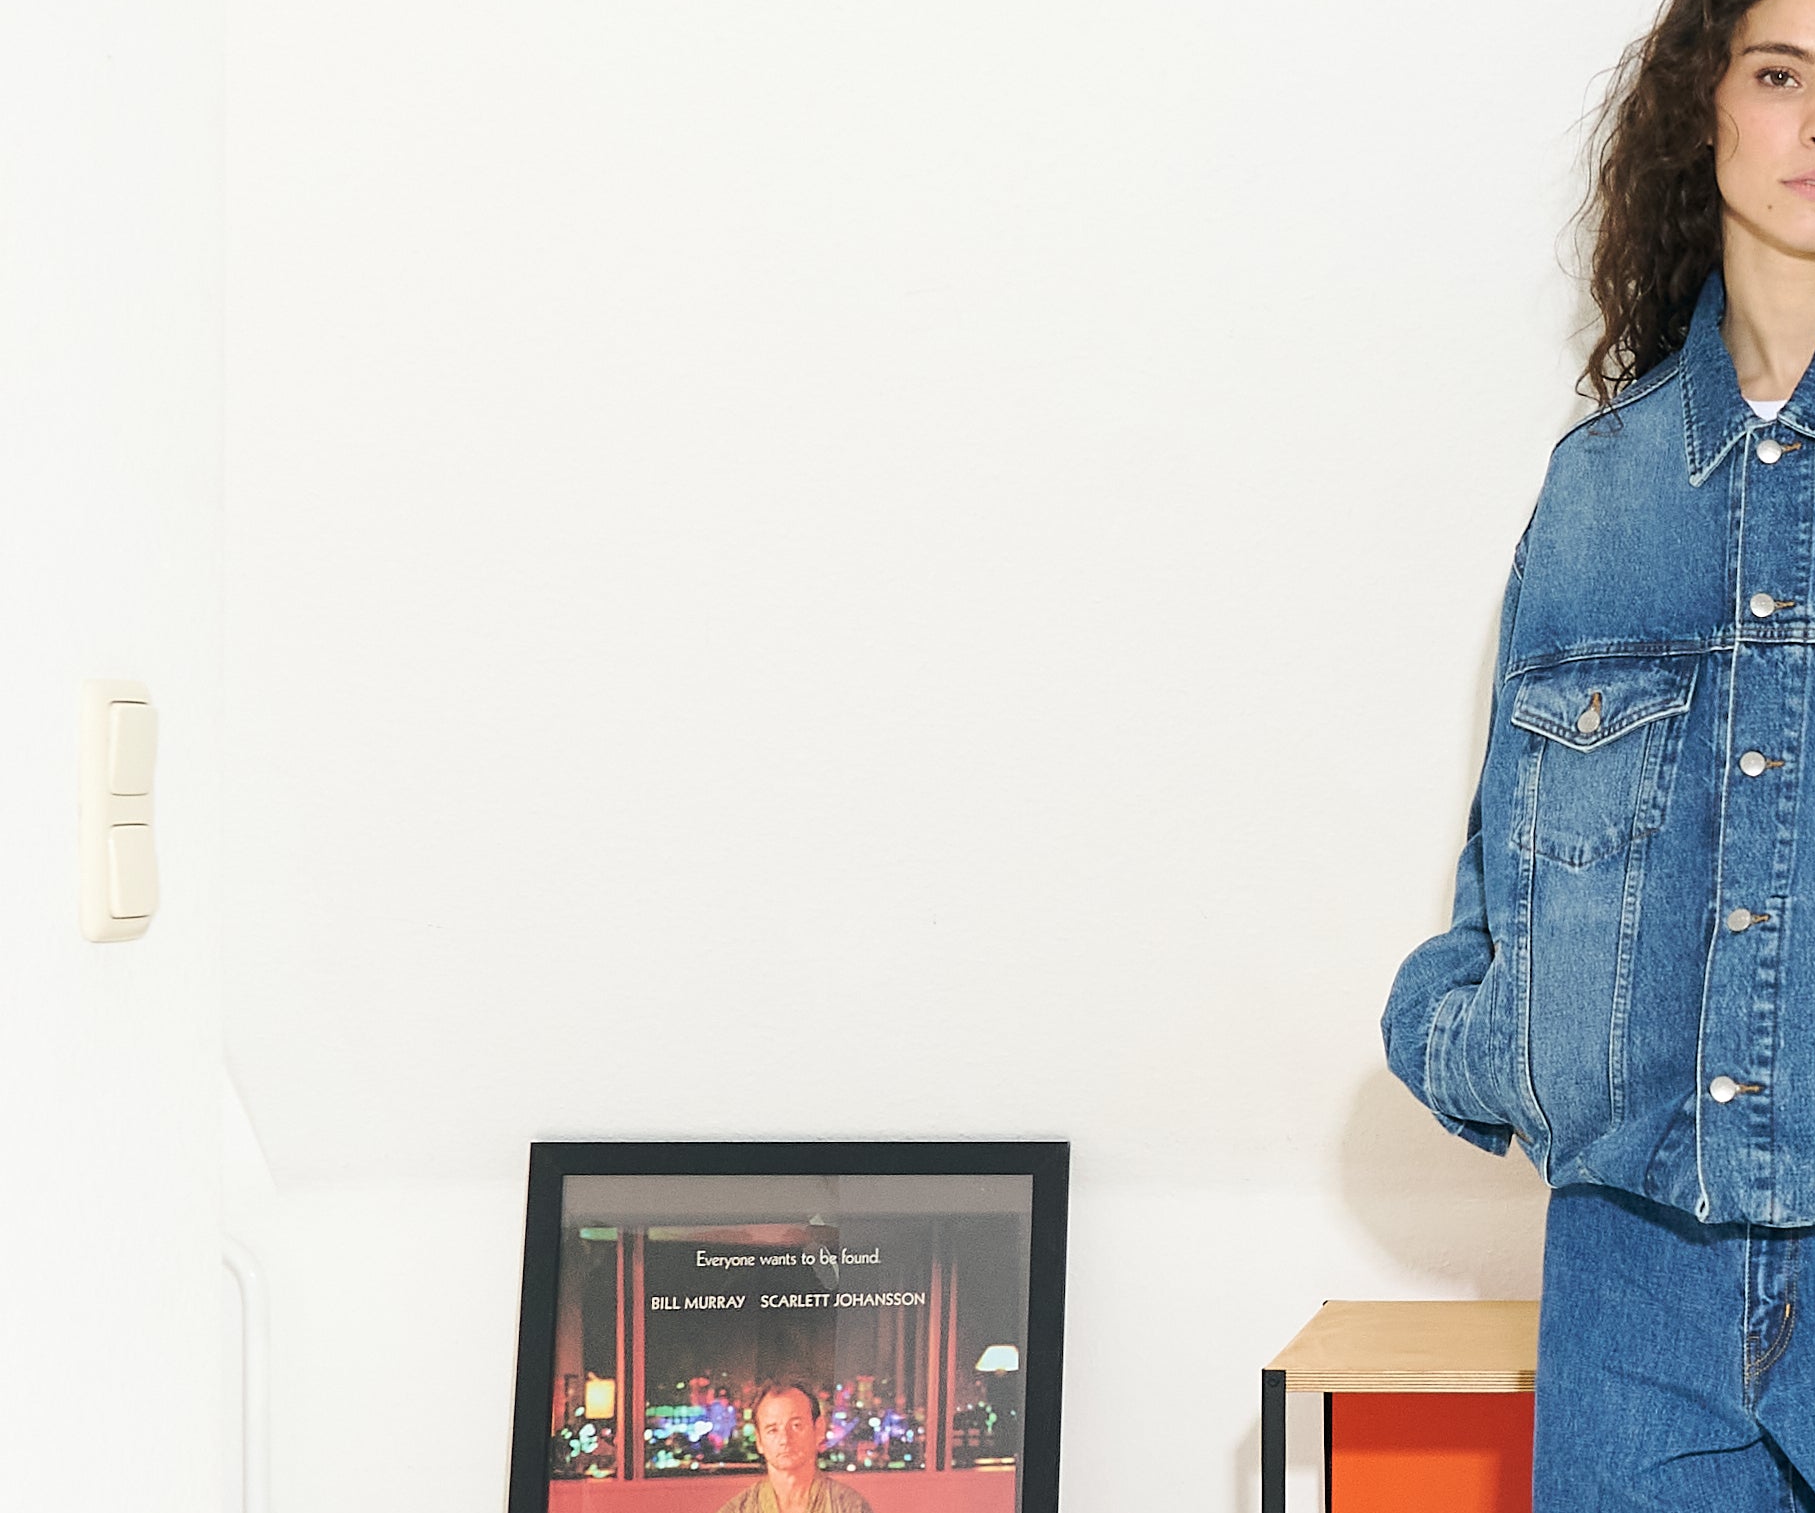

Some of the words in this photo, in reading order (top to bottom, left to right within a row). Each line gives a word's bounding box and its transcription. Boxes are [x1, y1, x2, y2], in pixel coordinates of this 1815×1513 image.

[696, 1250, 755, 1269] Everyone
[759, 1253, 797, 1266] wants
[801, 1253, 815, 1266] to
[819, 1249, 837, 1265] be
[841, 1248, 881, 1265] found.
[651, 1295, 681, 1310] BILL
[684, 1295, 746, 1310] MURRAY
[760, 1293, 830, 1308] SCARLETT
[833, 1292, 926, 1308] JOHANSSON
